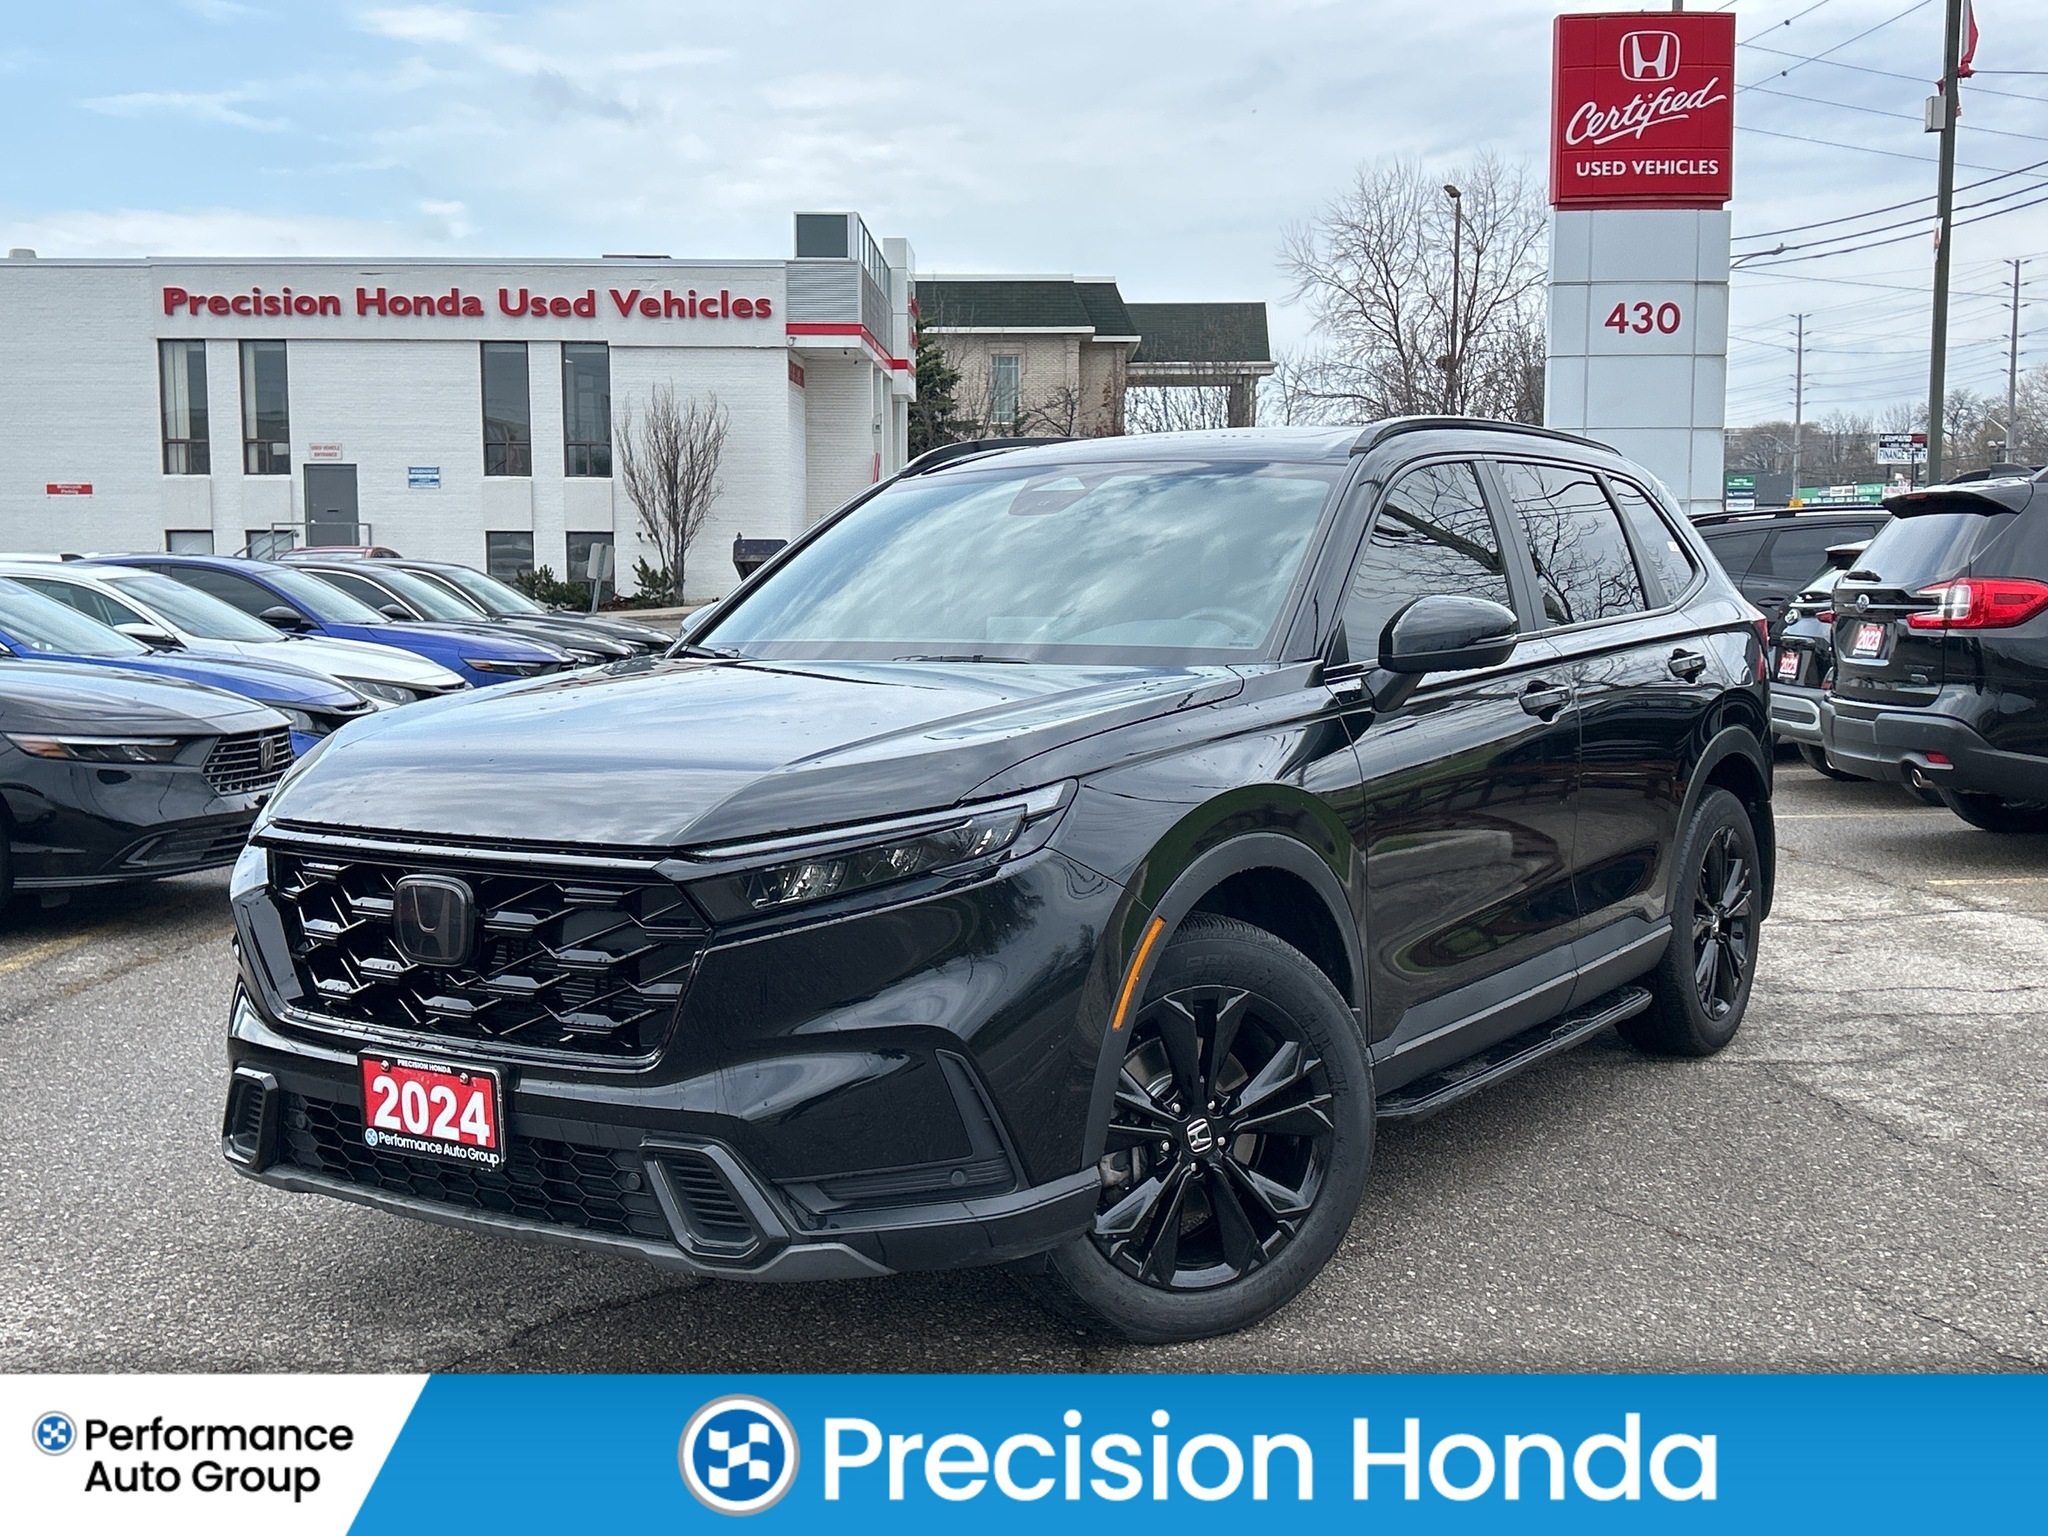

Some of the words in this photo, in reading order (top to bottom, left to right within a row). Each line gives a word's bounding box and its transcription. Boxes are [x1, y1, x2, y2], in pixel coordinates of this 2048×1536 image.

[1565, 76, 1727, 145] Certified
[1576, 161, 1627, 177] USED
[1631, 159, 1719, 175] VEHICLES
[164, 288, 340, 315] Precision
[357, 288, 482, 315] Honda
[499, 289, 595, 317] Used
[611, 290, 771, 318] Vehicles
[1604, 302, 1681, 335] 430
[1856, 630, 1882, 651] 2023
[397, 1058, 430, 1071] PRECISION
[429, 1063, 452, 1074] HONDA
[372, 1075, 491, 1147] 2024
[378, 1131, 443, 1154] Performance
[443, 1143, 467, 1159] Auto
[467, 1147, 500, 1168] Group
